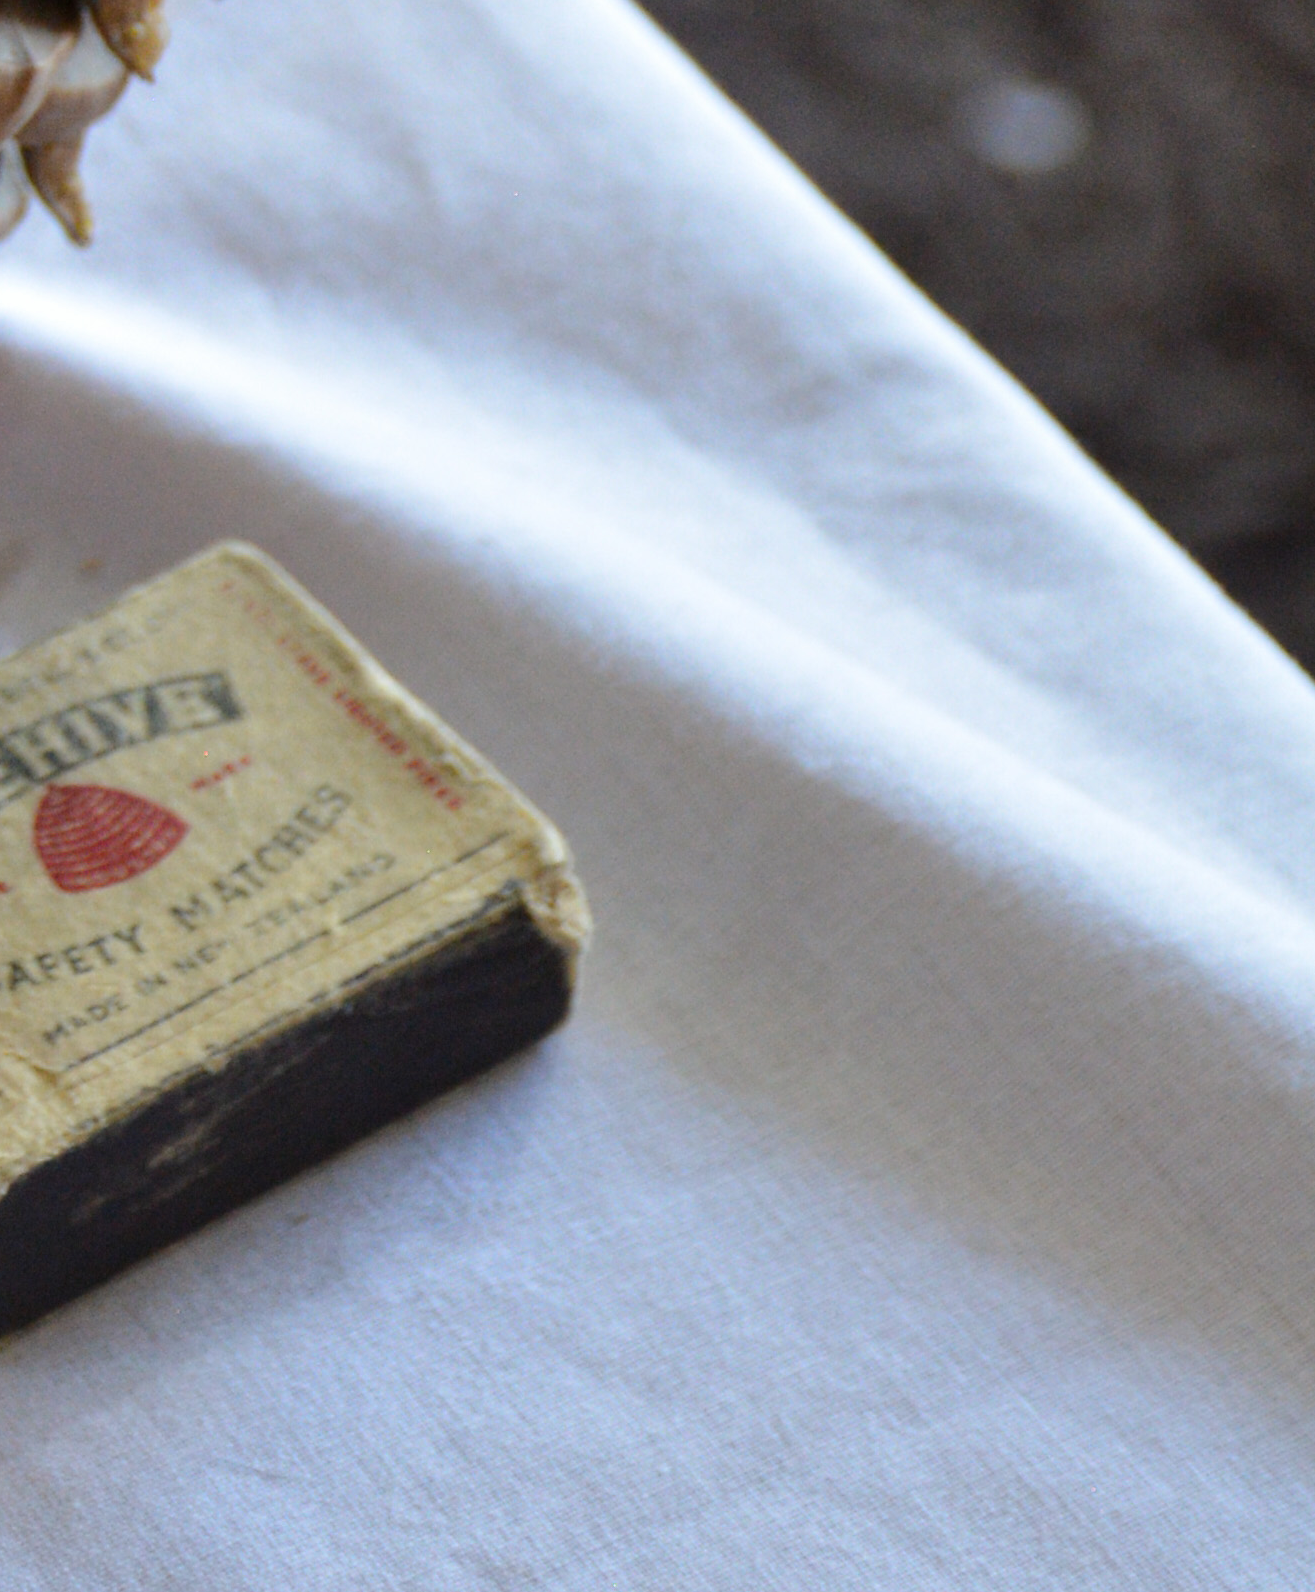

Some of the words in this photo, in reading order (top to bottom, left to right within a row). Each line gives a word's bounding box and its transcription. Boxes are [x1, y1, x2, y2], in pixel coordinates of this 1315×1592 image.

[170, 783, 354, 933] MATCHES
[42, 994, 129, 1046] MADE
[137, 972, 169, 996] IN
